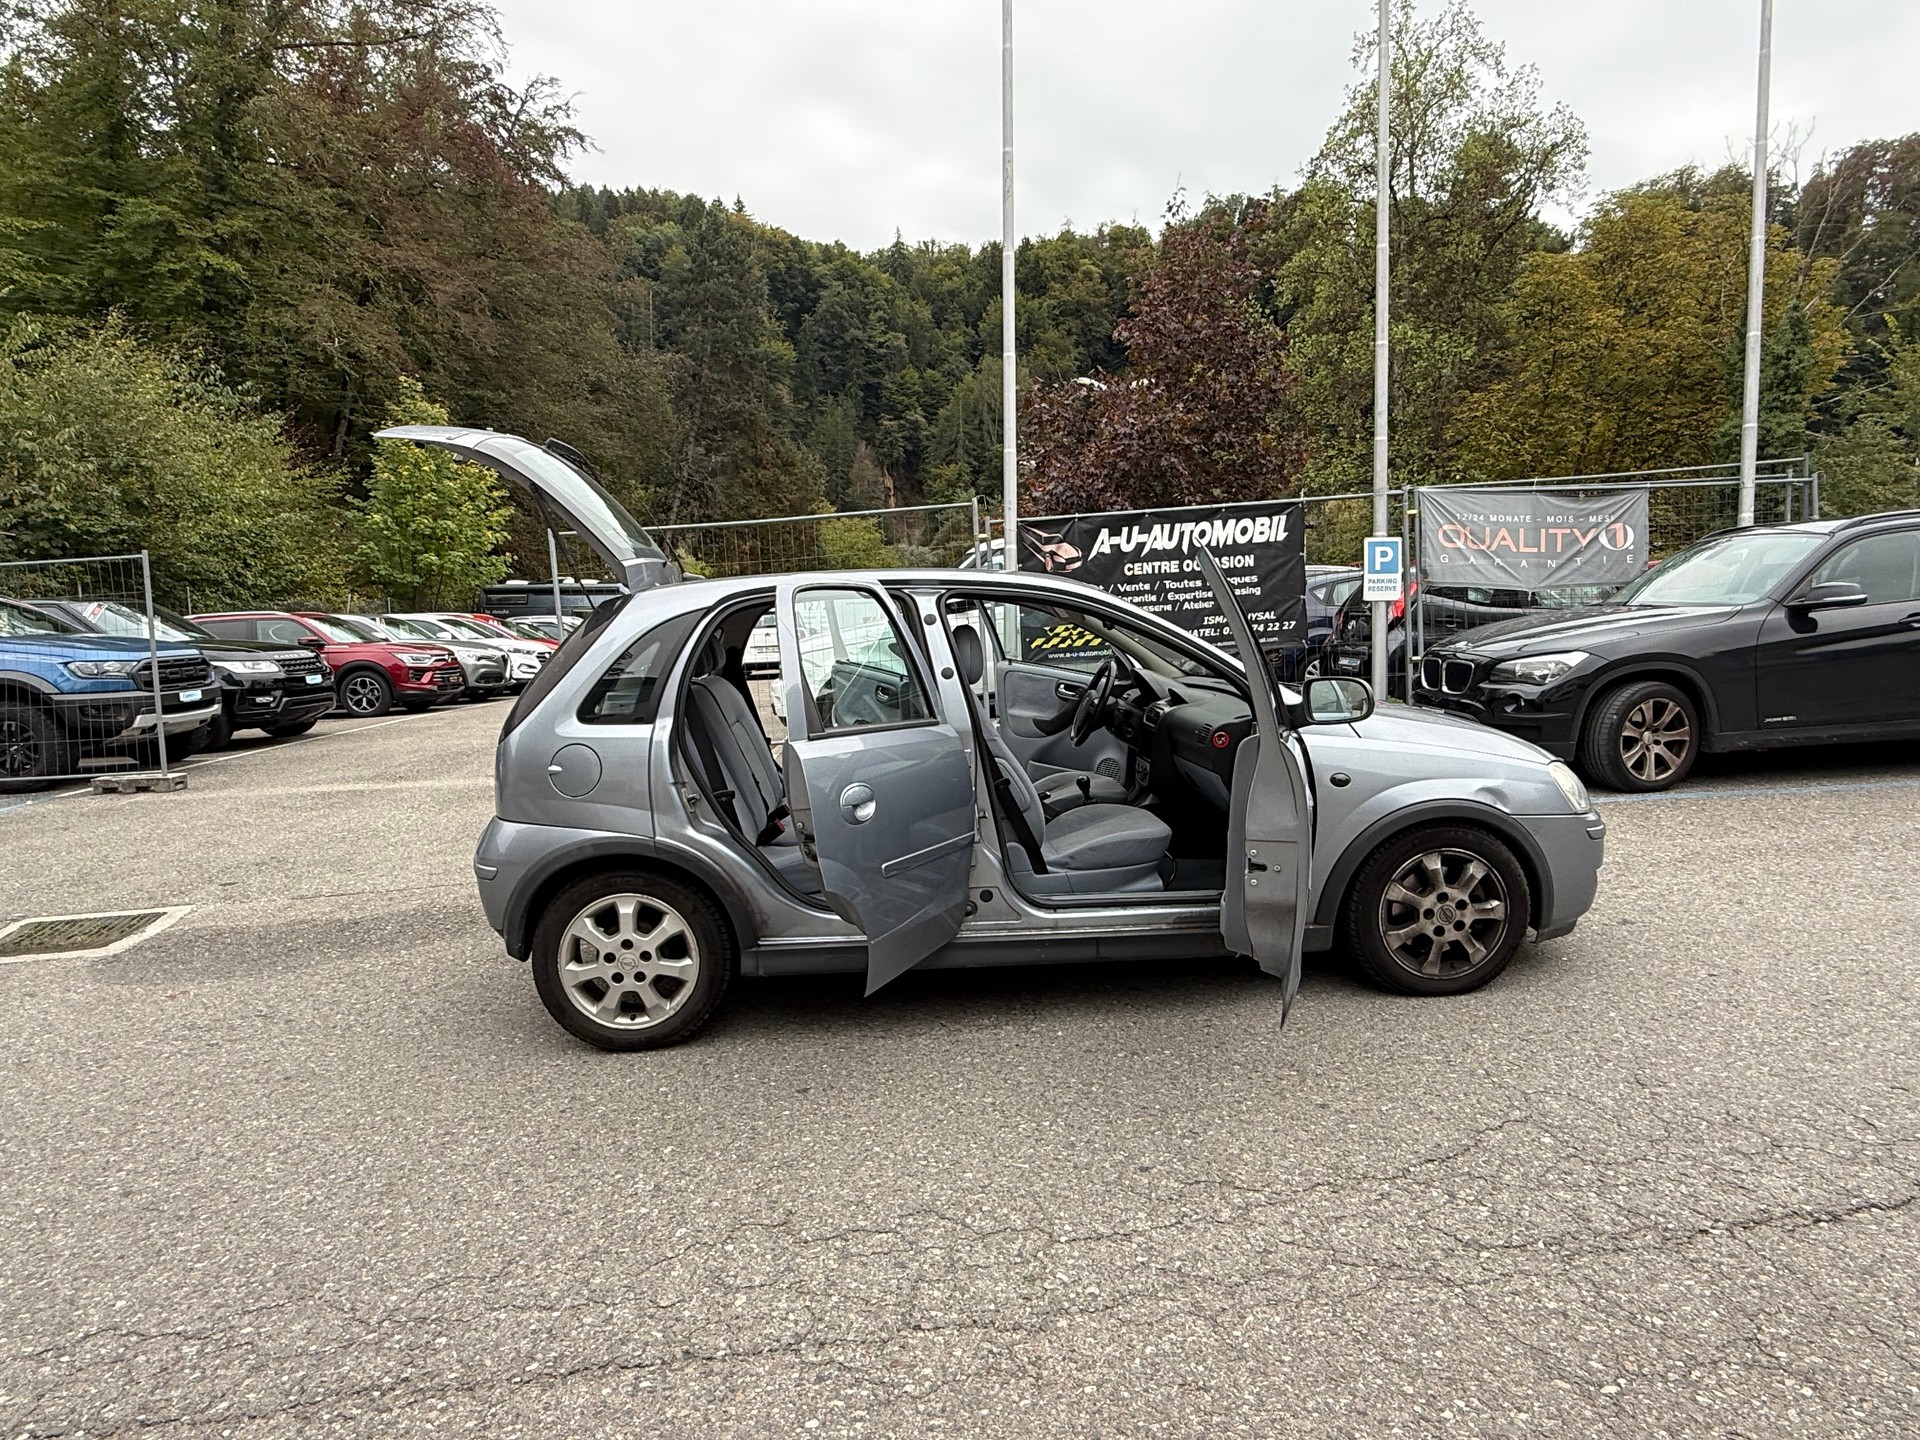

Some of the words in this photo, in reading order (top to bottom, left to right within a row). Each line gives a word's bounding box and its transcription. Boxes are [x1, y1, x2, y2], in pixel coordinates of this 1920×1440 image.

[1456, 513, 1485, 522] 12/24
[1489, 514, 1532, 523] MONATE
[1546, 515, 1575, 523] MOIS
[1088, 515, 1289, 562] A-U-AUTOMOBIL
[1438, 524, 1597, 553] QUALITY
[1123, 560, 1180, 576] CENTRE
[1183, 555, 1255, 572] OCASION
[1374, 546, 1394, 571] P
[1440, 554, 1634, 568] GARANTIE
[1117, 582, 1151, 592] Vente
[1163, 579, 1202, 590] Toutes
[1118, 593, 1157, 603] arantie
[1167, 588, 1213, 602] Expertise
[1182, 600, 1215, 610] Atelier
[1267, 622, 1280, 631] 22
[1282, 620, 1297, 630] 27
